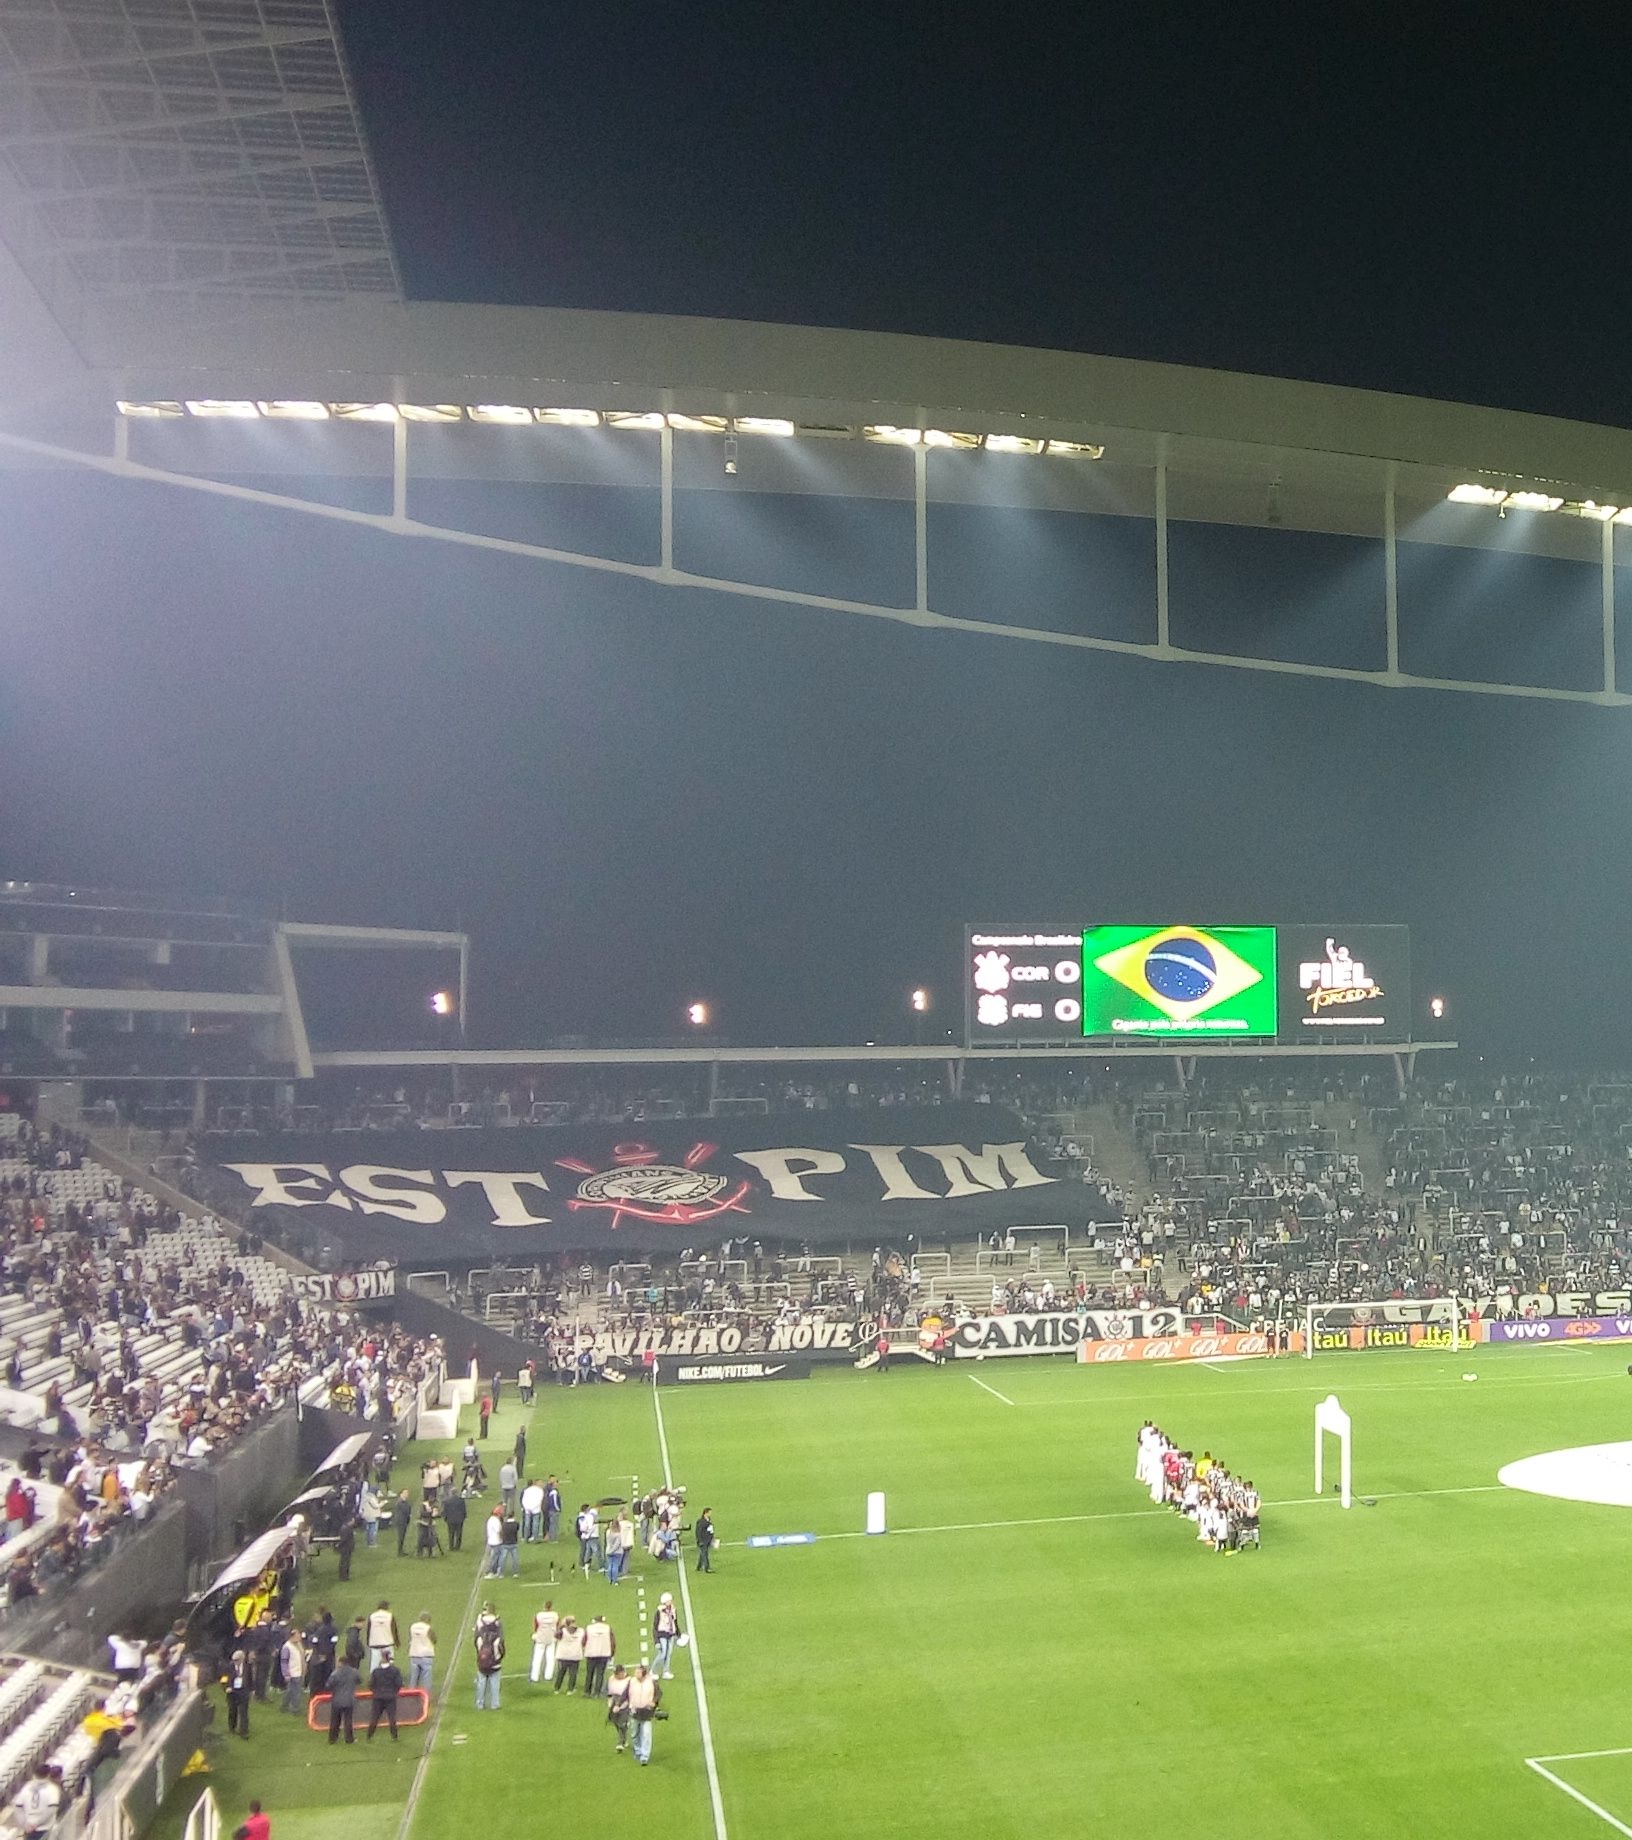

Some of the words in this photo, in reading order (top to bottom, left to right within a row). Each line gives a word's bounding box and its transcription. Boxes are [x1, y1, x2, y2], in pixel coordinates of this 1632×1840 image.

[1300, 963, 1374, 989] FIEL
[220, 1163, 553, 1226] EST
[733, 1142, 1062, 1200] PIM
[356, 1270, 395, 1299] PIM
[769, 1322, 855, 1350] NOVE
[957, 1315, 1102, 1349] CAMISA
[1129, 1313, 1178, 1338] 12
[1367, 1327, 1407, 1346] Itaú
[678, 1363, 764, 1380] NIKE.COM/FUTEBOL
